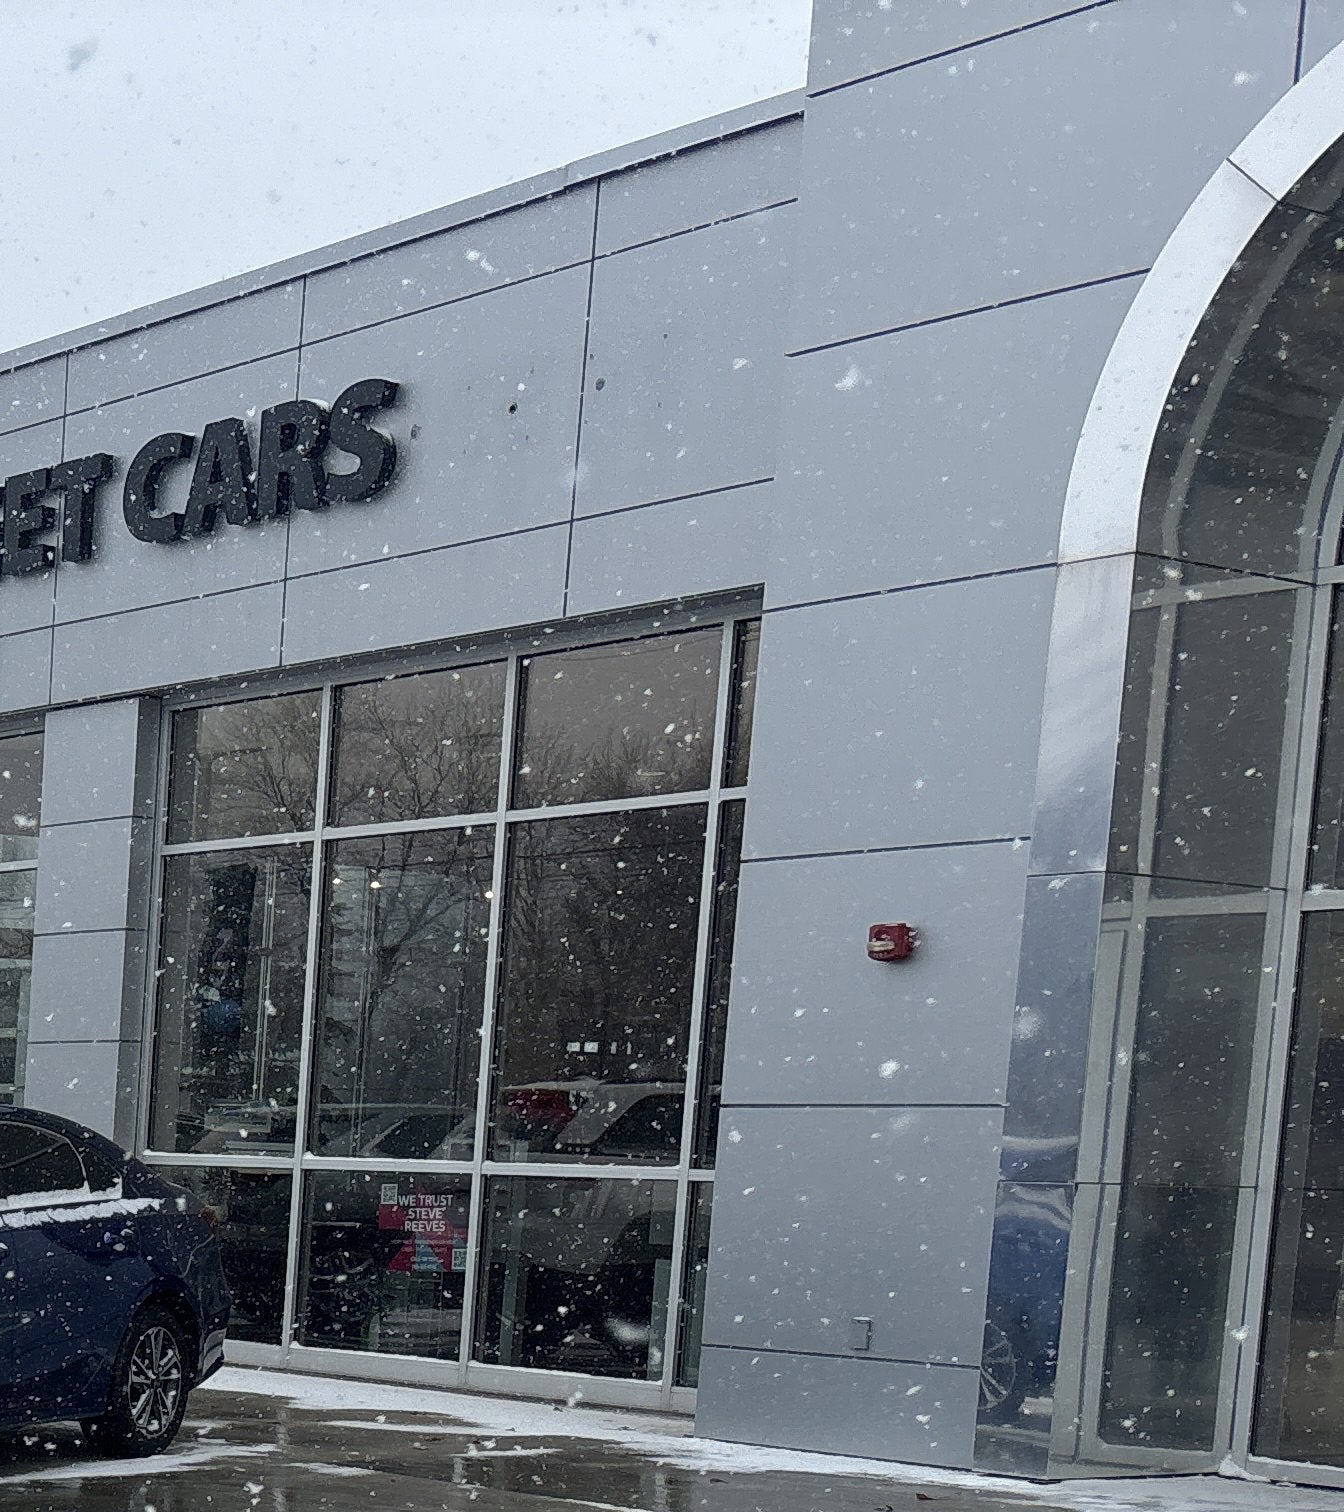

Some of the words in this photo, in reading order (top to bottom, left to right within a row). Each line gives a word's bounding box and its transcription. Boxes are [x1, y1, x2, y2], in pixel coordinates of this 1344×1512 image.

[123, 378, 400, 544] CARS
[398, 1195, 416, 1206] WE
[418, 1194, 453, 1206] TRUST
[407, 1207, 443, 1219] STEVE
[405, 1221, 445, 1232] REEVES
